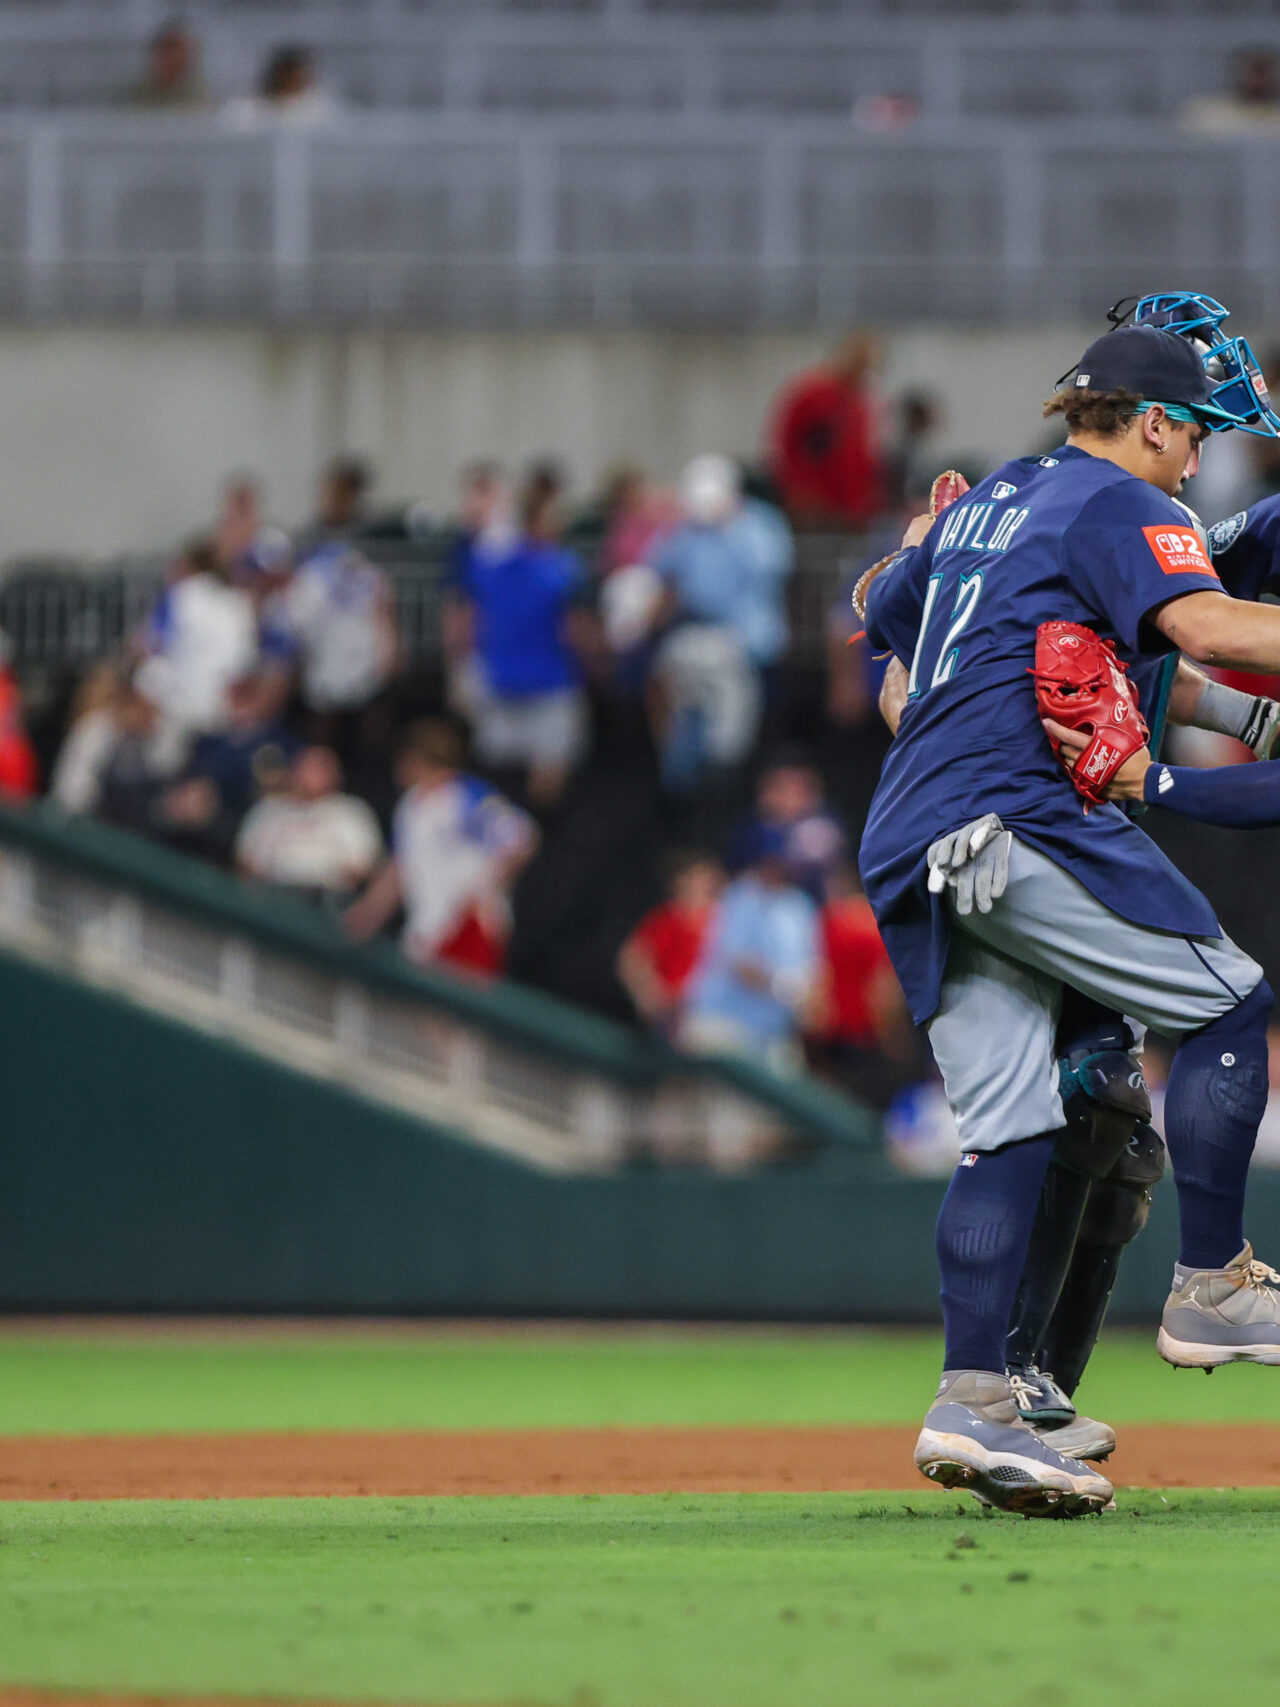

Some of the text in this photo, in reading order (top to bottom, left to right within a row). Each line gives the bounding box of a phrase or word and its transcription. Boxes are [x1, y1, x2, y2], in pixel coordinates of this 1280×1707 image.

[933, 502, 1031, 561] NAYLOR
[1181, 534, 1204, 557] 2
[907, 569, 984, 699] 12
